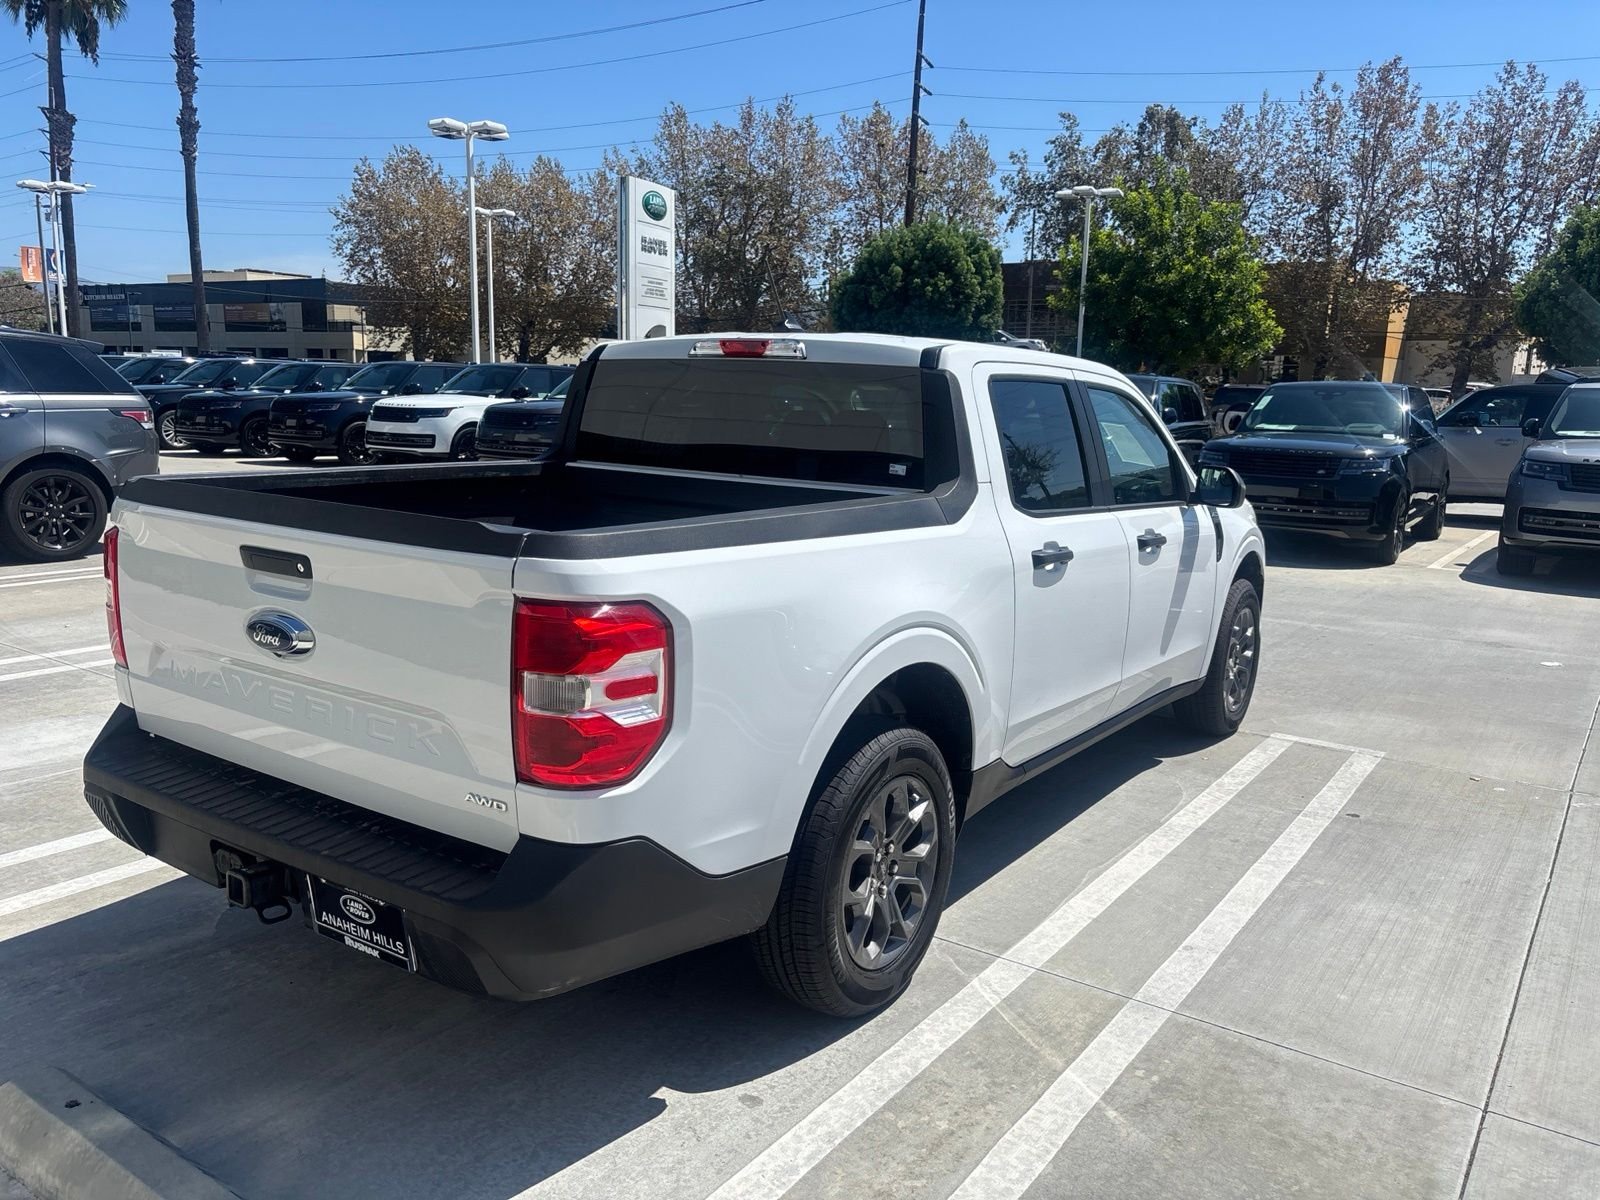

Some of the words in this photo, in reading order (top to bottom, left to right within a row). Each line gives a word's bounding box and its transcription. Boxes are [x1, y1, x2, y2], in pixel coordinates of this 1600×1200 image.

[253, 622, 281, 646] Ford
[168, 659, 442, 756] MAVERICK
[464, 791, 508, 812] AWD
[347, 899, 363, 910] LAND
[350, 906, 370, 920] ROVER
[321, 911, 371, 941] ANAHEIM
[372, 931, 405, 955] HILLS
[344, 935, 380, 959] RUSNAK
